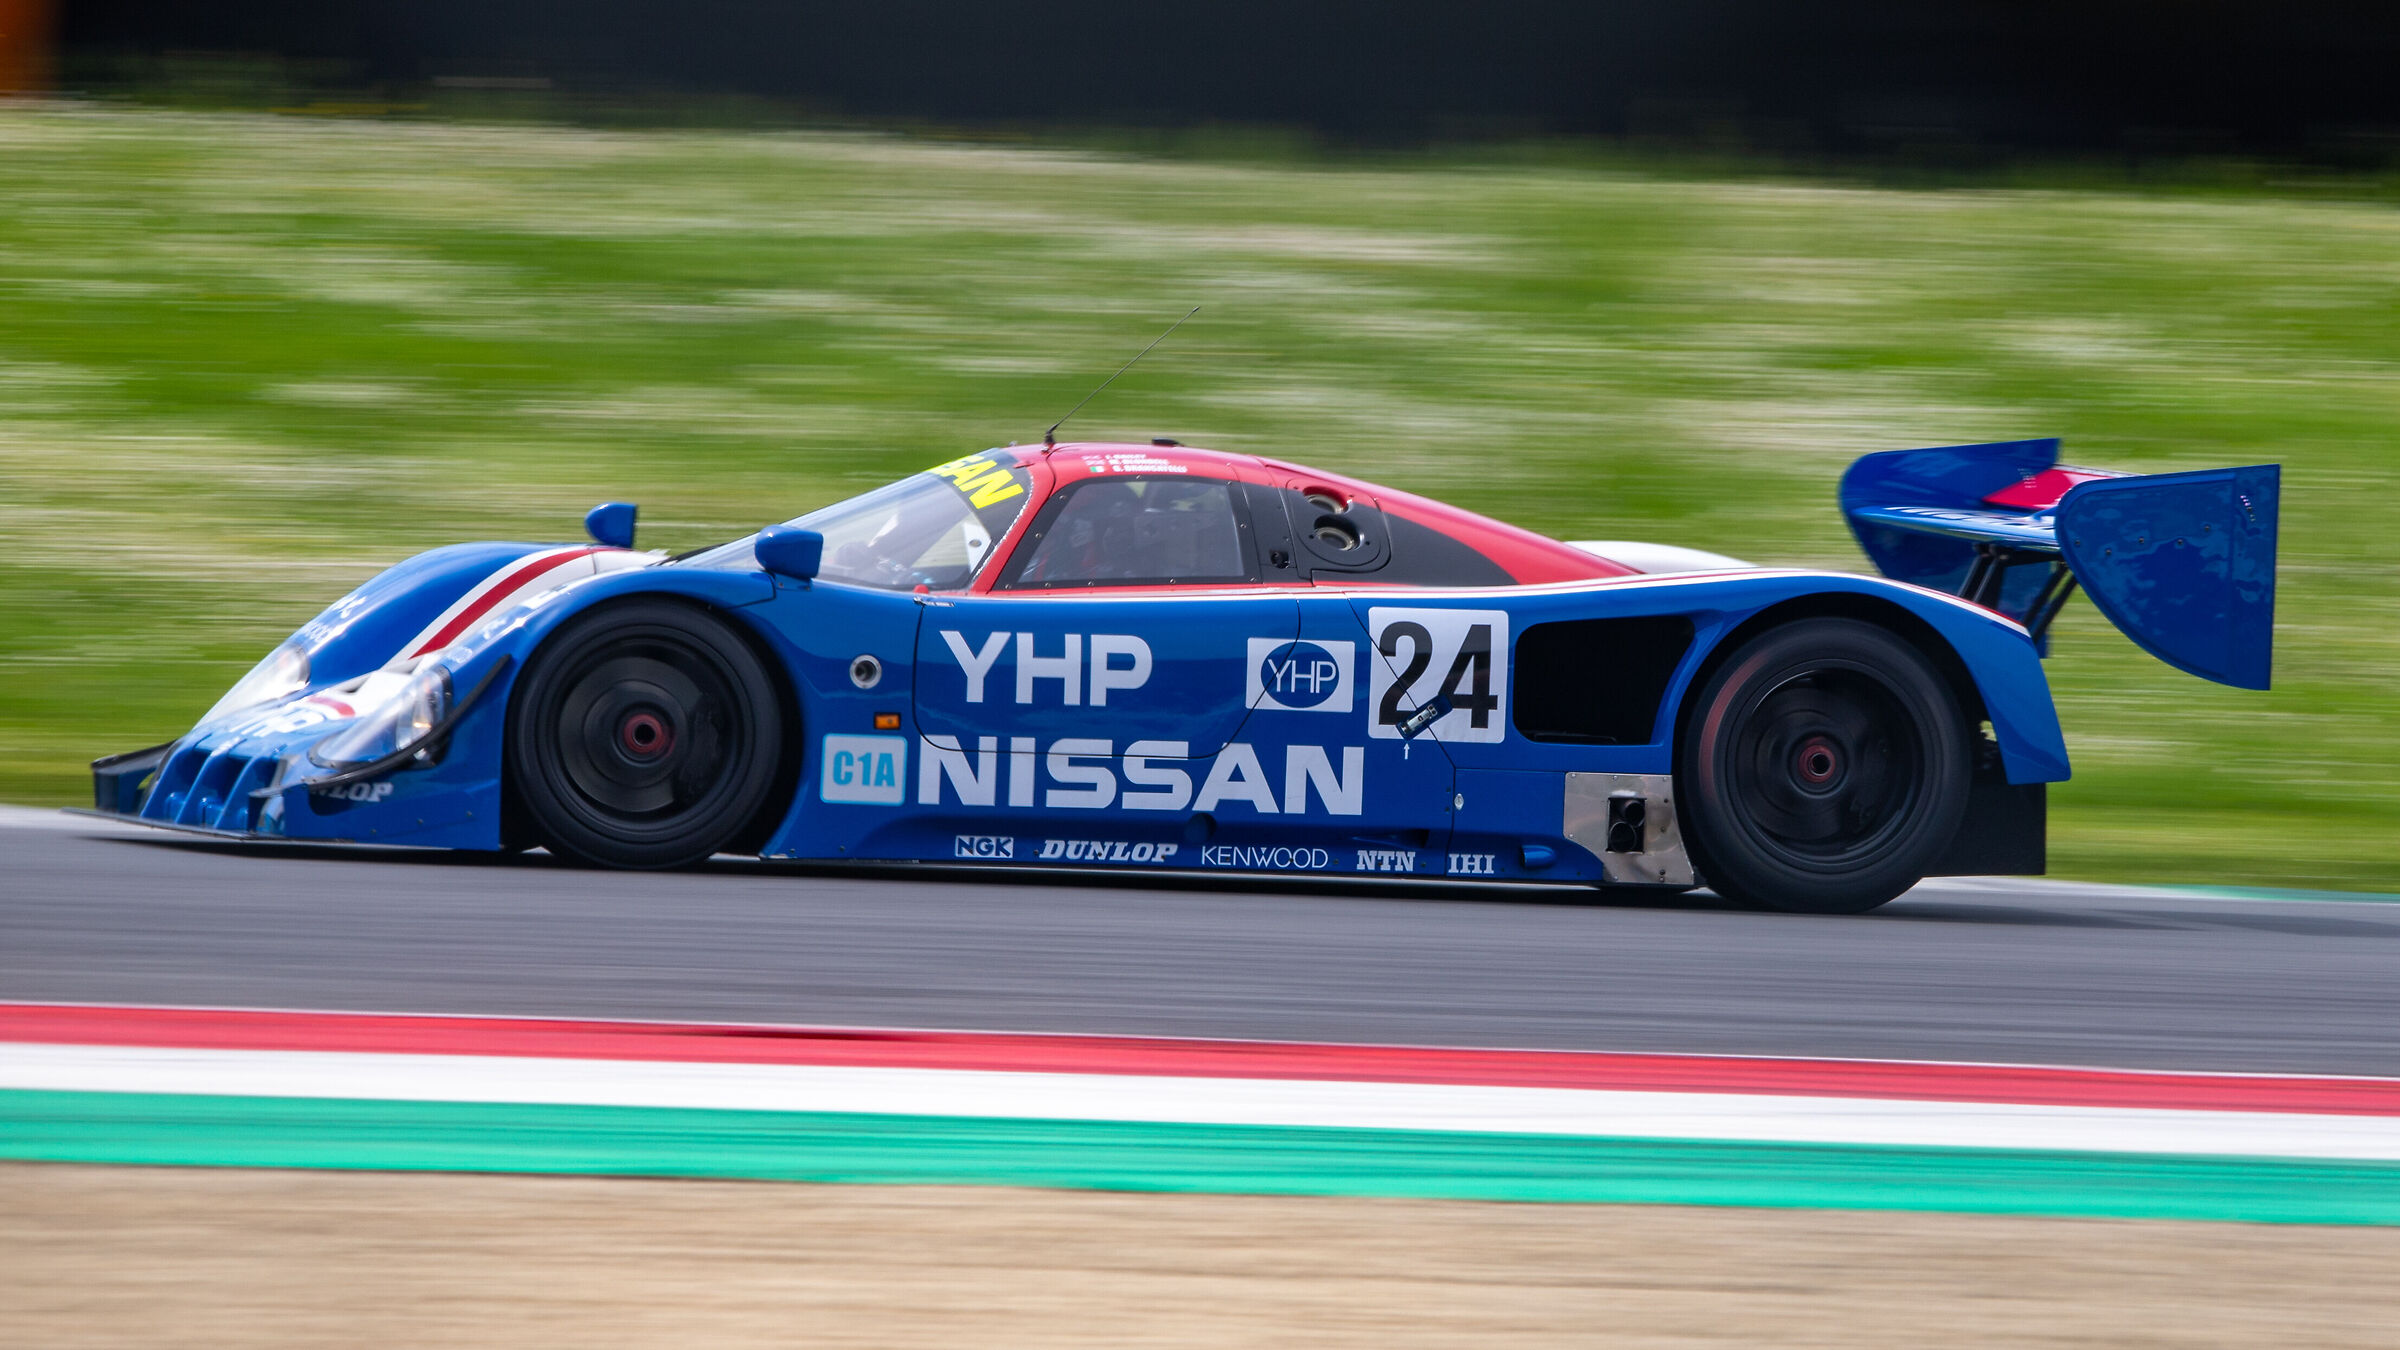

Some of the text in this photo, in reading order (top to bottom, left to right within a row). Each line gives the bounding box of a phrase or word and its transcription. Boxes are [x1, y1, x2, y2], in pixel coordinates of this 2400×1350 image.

[941, 631, 1152, 706] YHP
[1268, 659, 1336, 693] YHP
[1379, 621, 1498, 729] 24
[833, 751, 896, 787] C1A
[918, 735, 1364, 814] NISSAN
[957, 836, 1012, 858] NGK
[1039, 839, 1178, 863] DUNLOP
[1202, 846, 1328, 868] KENWOOD
[1357, 850, 1415, 872] NTN
[1449, 853, 1494, 874] IHI
